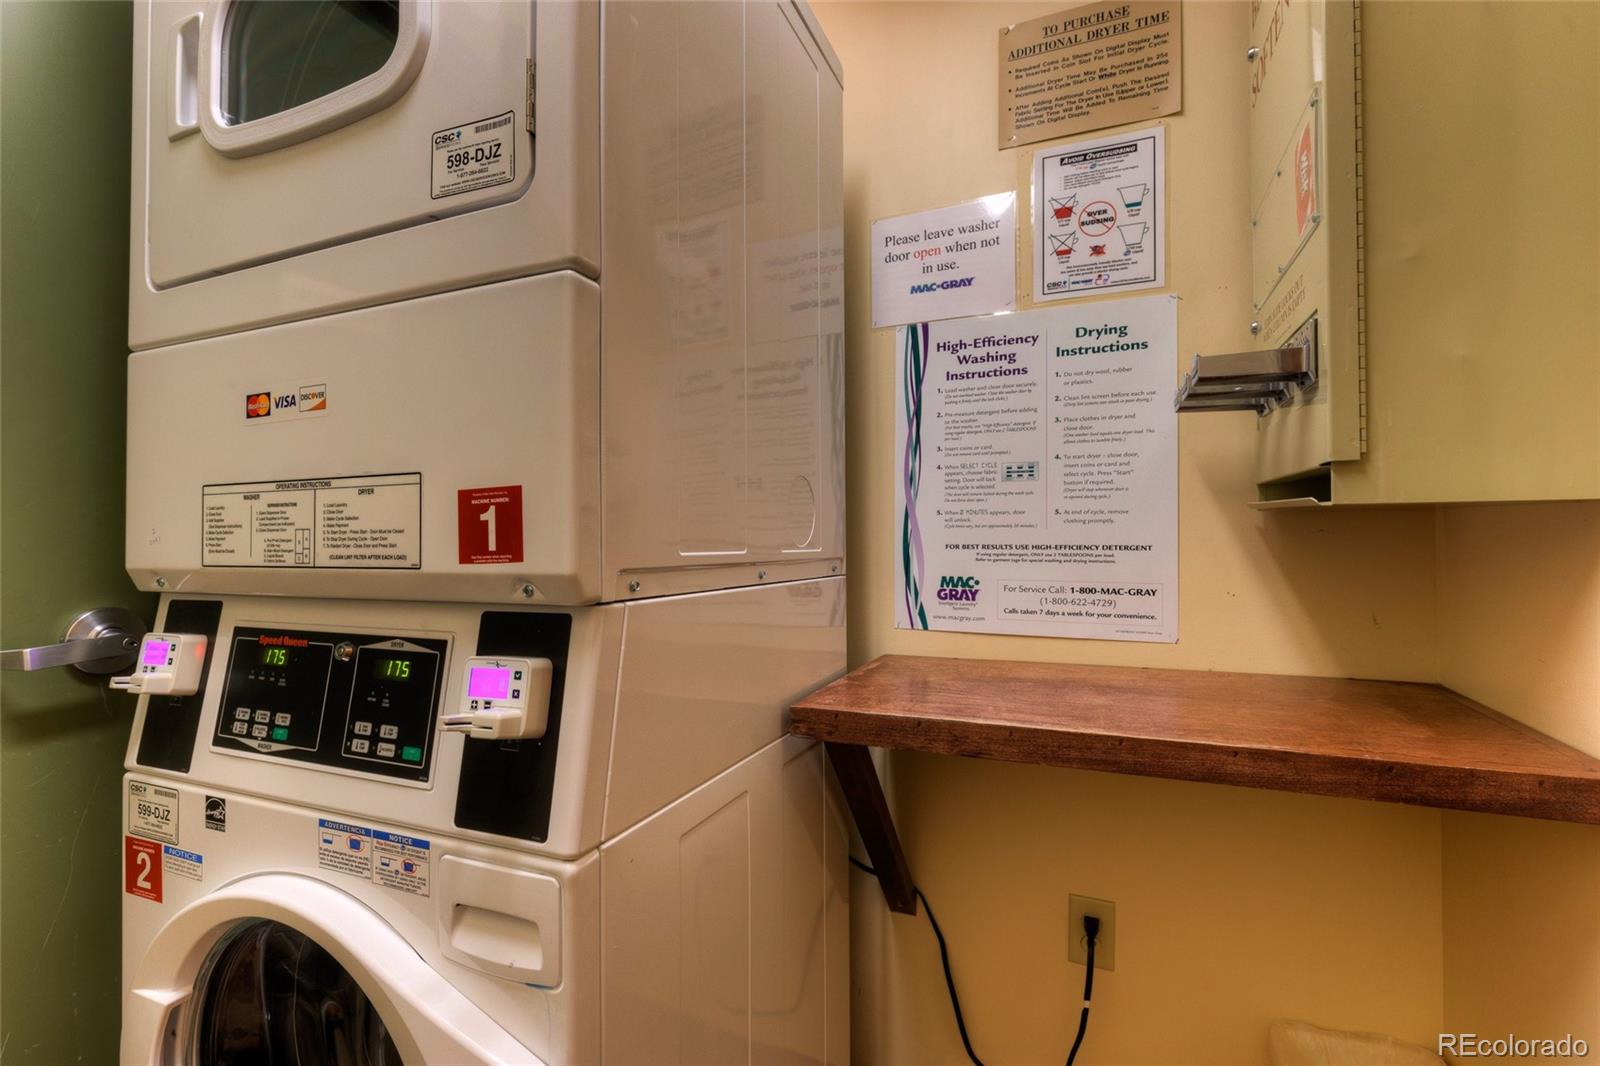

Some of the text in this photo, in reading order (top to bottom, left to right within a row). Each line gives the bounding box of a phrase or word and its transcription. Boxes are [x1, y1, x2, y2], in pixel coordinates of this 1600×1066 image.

[1042, 5, 1130, 36] TO PURCHASE
[1008, 10, 1169, 59] ADDITIONAL DRYER TIME
[435, 133, 455, 144] CSC
[447, 143, 501, 169] 598-DJZ
[1087, 209, 1107, 217] OVER
[1080, 217, 1114, 226] SUDSING
[885, 219, 1000, 248] Please leave washer
[885, 236, 1000, 263] door open when not
[922, 261, 959, 274] in use.
[1075, 324, 1128, 340] Drying
[937, 334, 1039, 354] High-Efficiency
[1056, 340, 1149, 357] Instructions
[957, 351, 1016, 365] Washing
[946, 366, 1028, 380] Instructions
[274, 392, 325, 409] VISA DISCOVER
[275, 482, 299, 490] OPERATING
[480, 505, 496, 551] 1
[1102, 544, 1152, 552] DETERGENT
[937, 589, 981, 601] GRAY
[1004, 585, 1158, 597] For Service Call: 1-800-MAC-GRAY
[1040, 597, 1117, 609] (1-800-622-4729)
[259, 635, 308, 647] Speed Queen
[266, 649, 286, 665] 175
[387, 660, 410, 677] 175
[138, 803, 171, 821] 599-DJZ
[324, 822, 366, 835] ADVERTENCIA
[389, 835, 413, 845] NOTICE
[169, 848, 198, 860] NOTICE
[137, 852, 151, 890] 2
